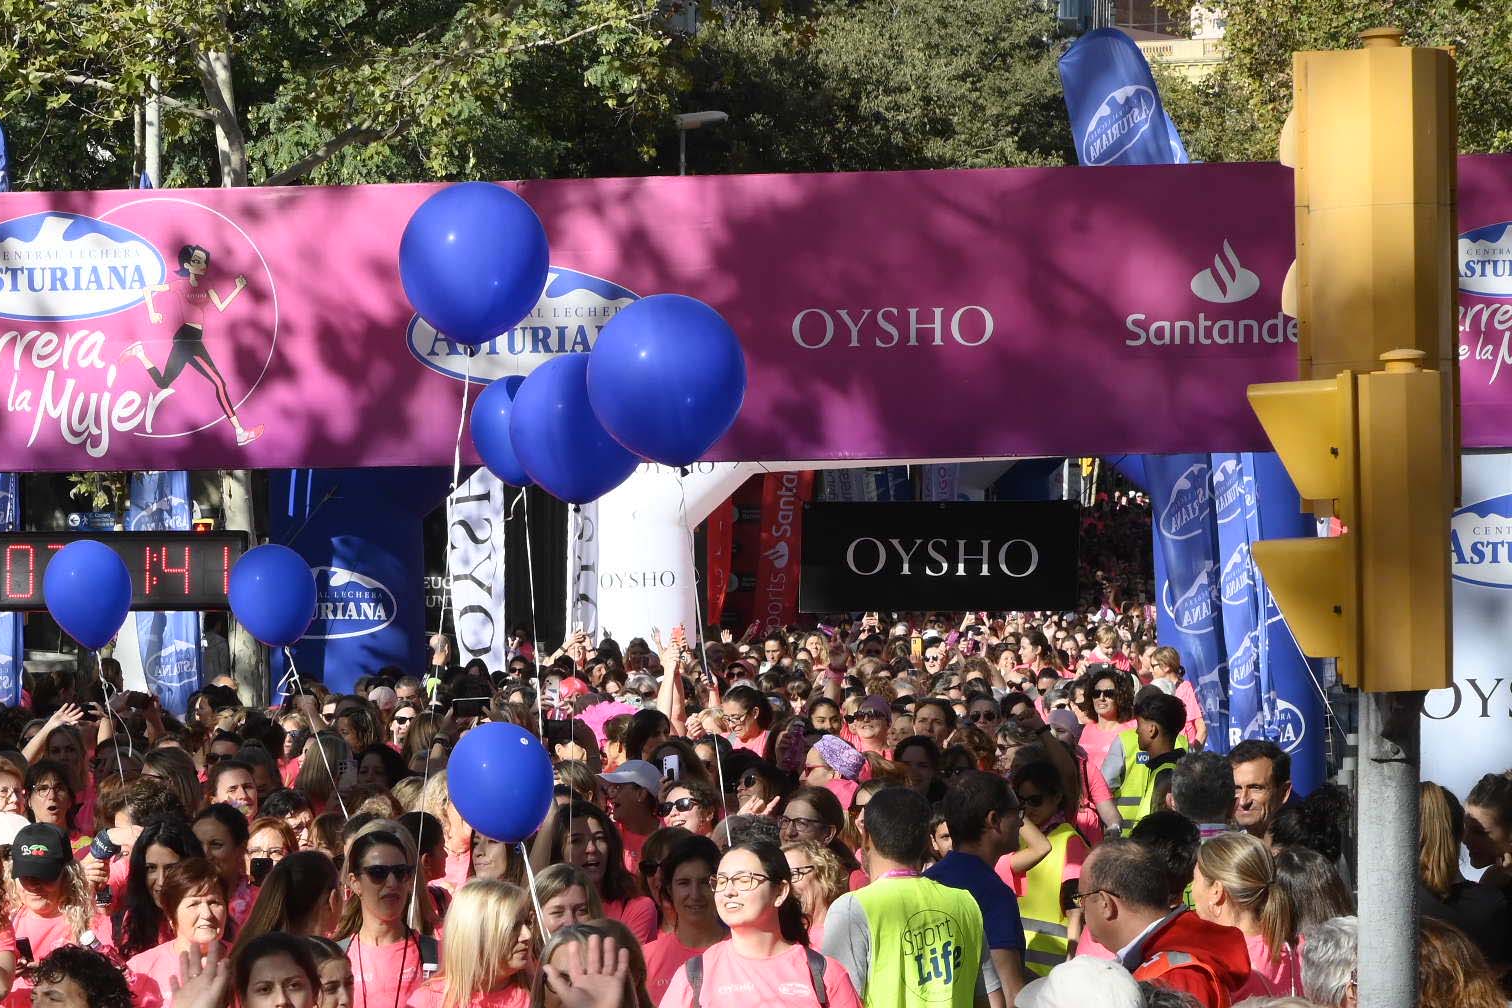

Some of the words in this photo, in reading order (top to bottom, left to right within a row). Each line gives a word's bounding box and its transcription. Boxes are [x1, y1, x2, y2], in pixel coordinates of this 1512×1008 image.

[791, 305, 994, 349] OYSHO
[7, 371, 31, 412] la
[26, 365, 176, 458] Mujer
[846, 537, 1039, 577] OYSHO
[600, 570, 676, 591] OYSHO
[904, 917, 954, 956] Sport
[915, 941, 962, 986] Life
